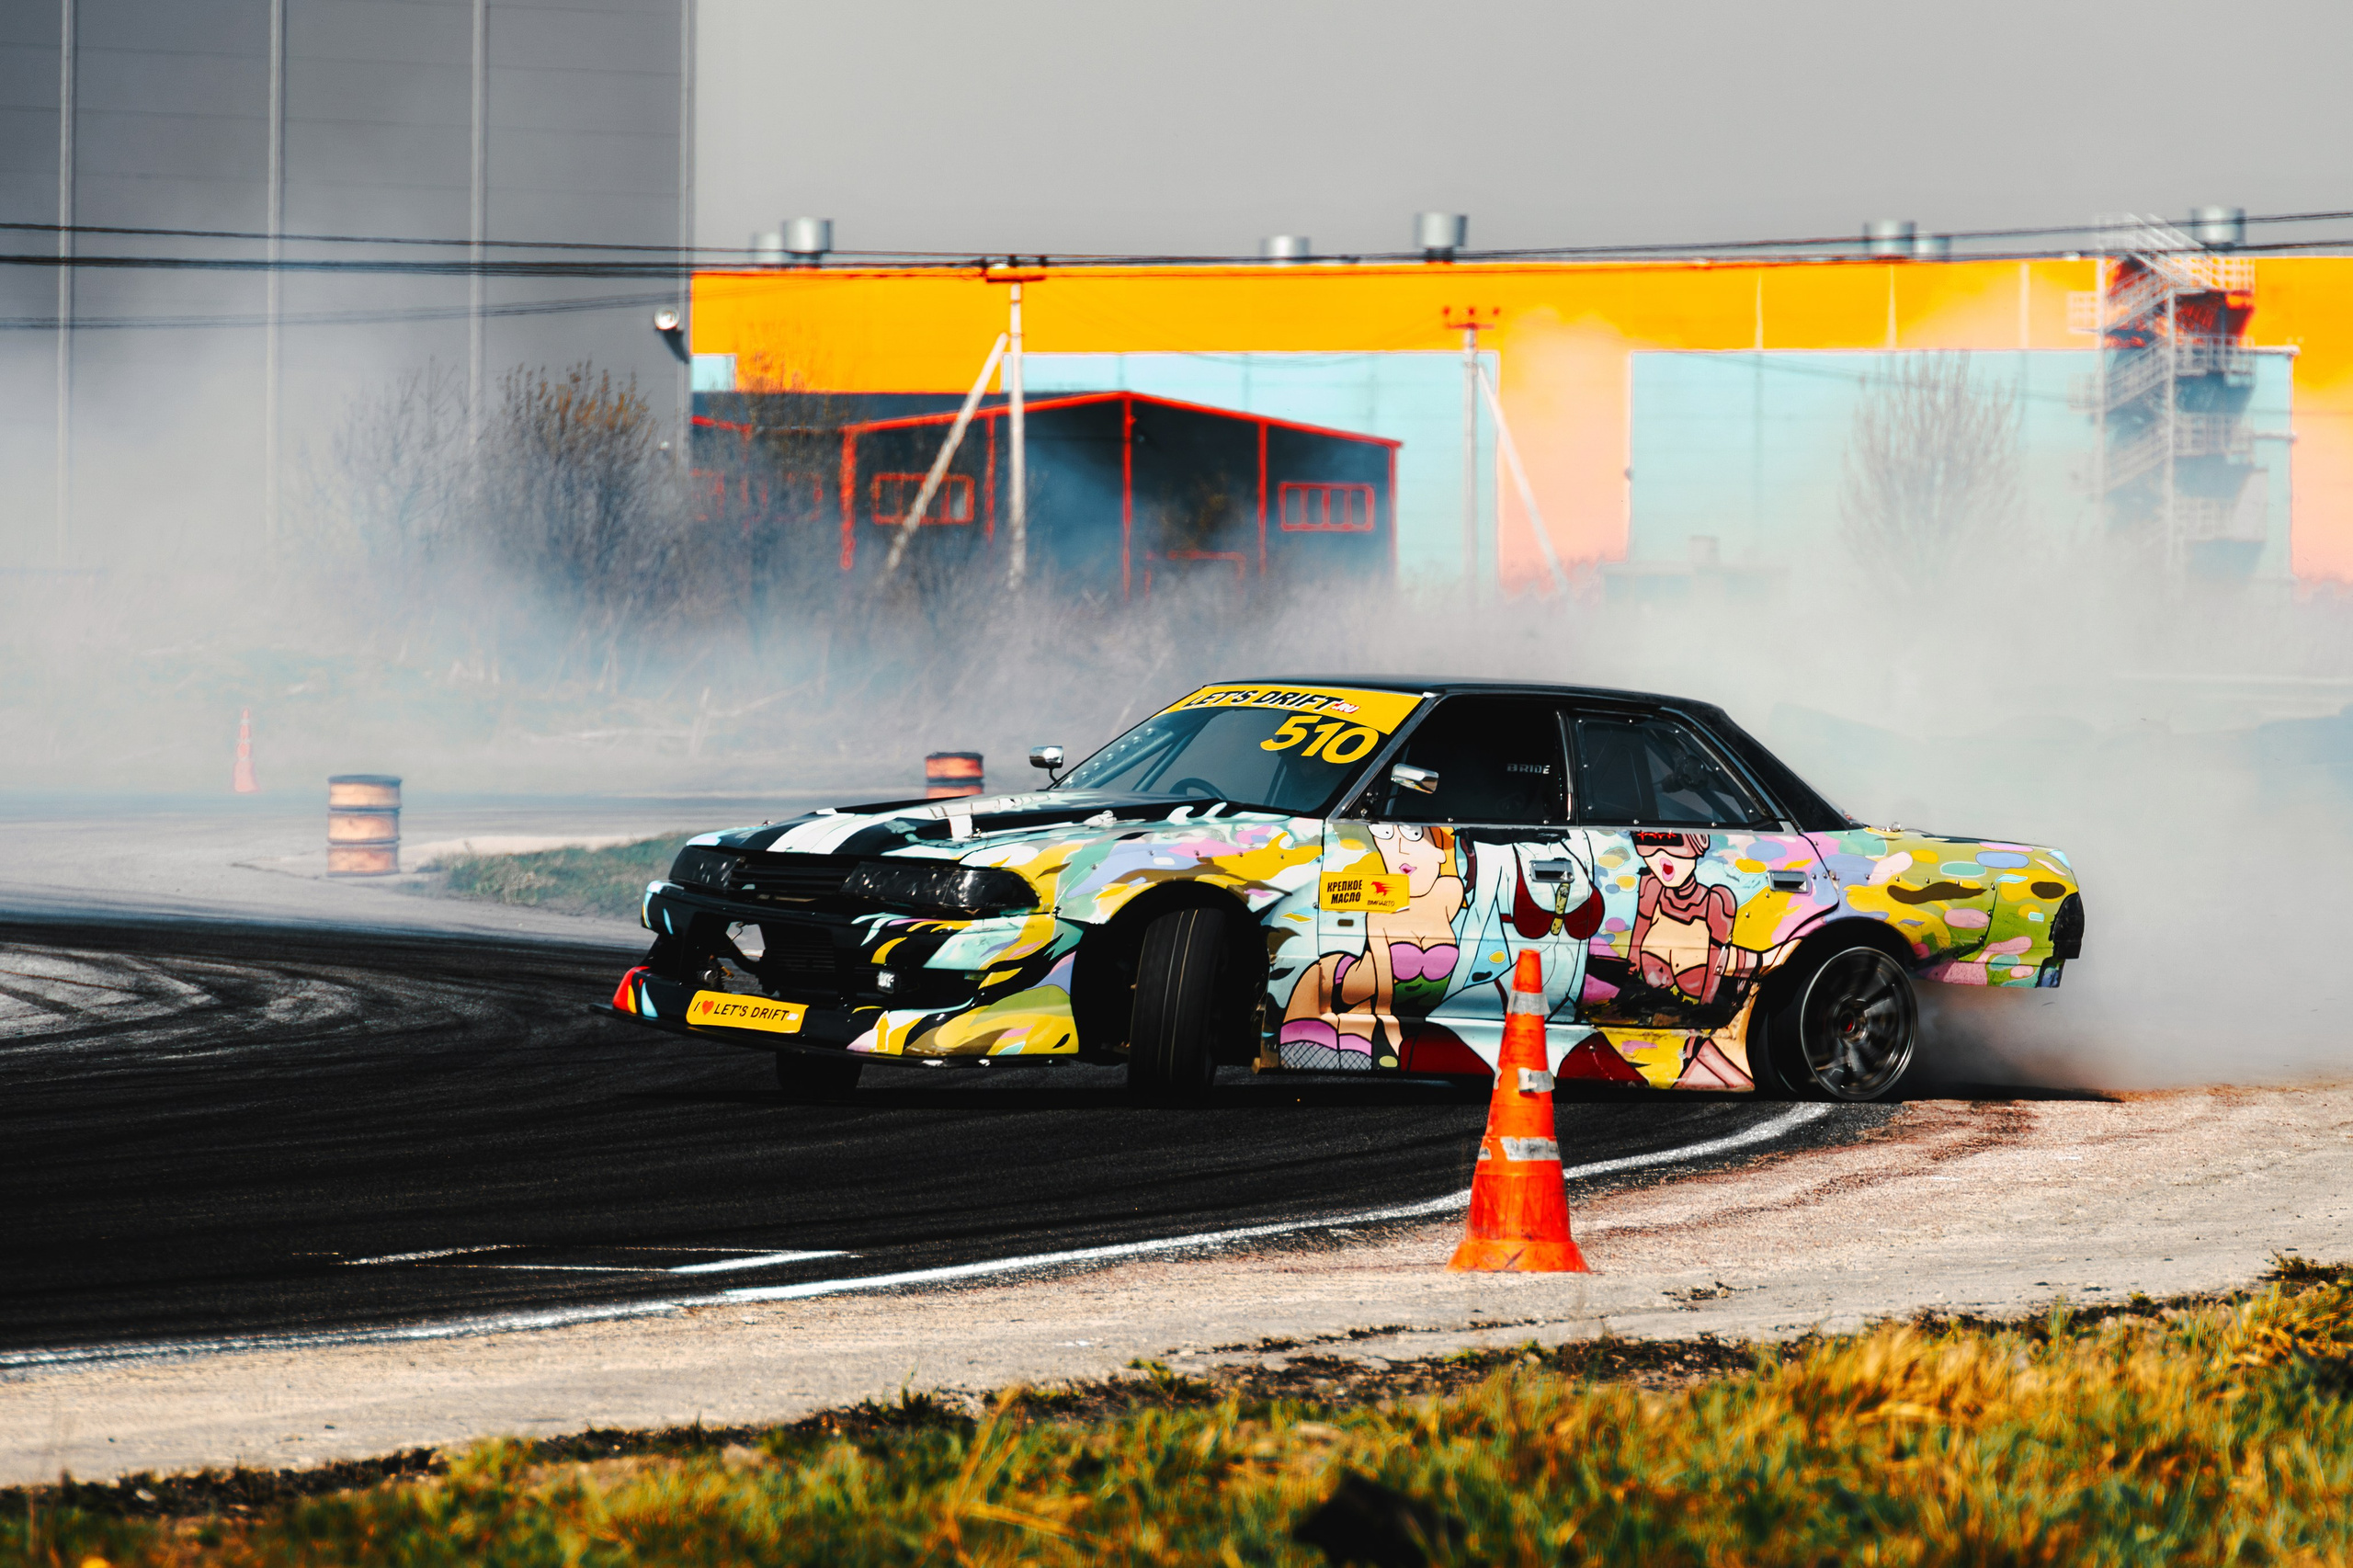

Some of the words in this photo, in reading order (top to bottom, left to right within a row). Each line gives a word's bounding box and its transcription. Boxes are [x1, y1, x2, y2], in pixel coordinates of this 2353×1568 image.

[1183, 690, 1259, 708] LET'S
[1260, 715, 1379, 764] 510
[1507, 764, 1551, 774] BRIDE
[1327, 880, 1362, 892] КРЕПКОЕ
[1331, 892, 1361, 904] МАСЛО
[694, 1001, 701, 1012] I
[713, 1003, 748, 1017] LET'S
[750, 1006, 790, 1021] DRIFT
